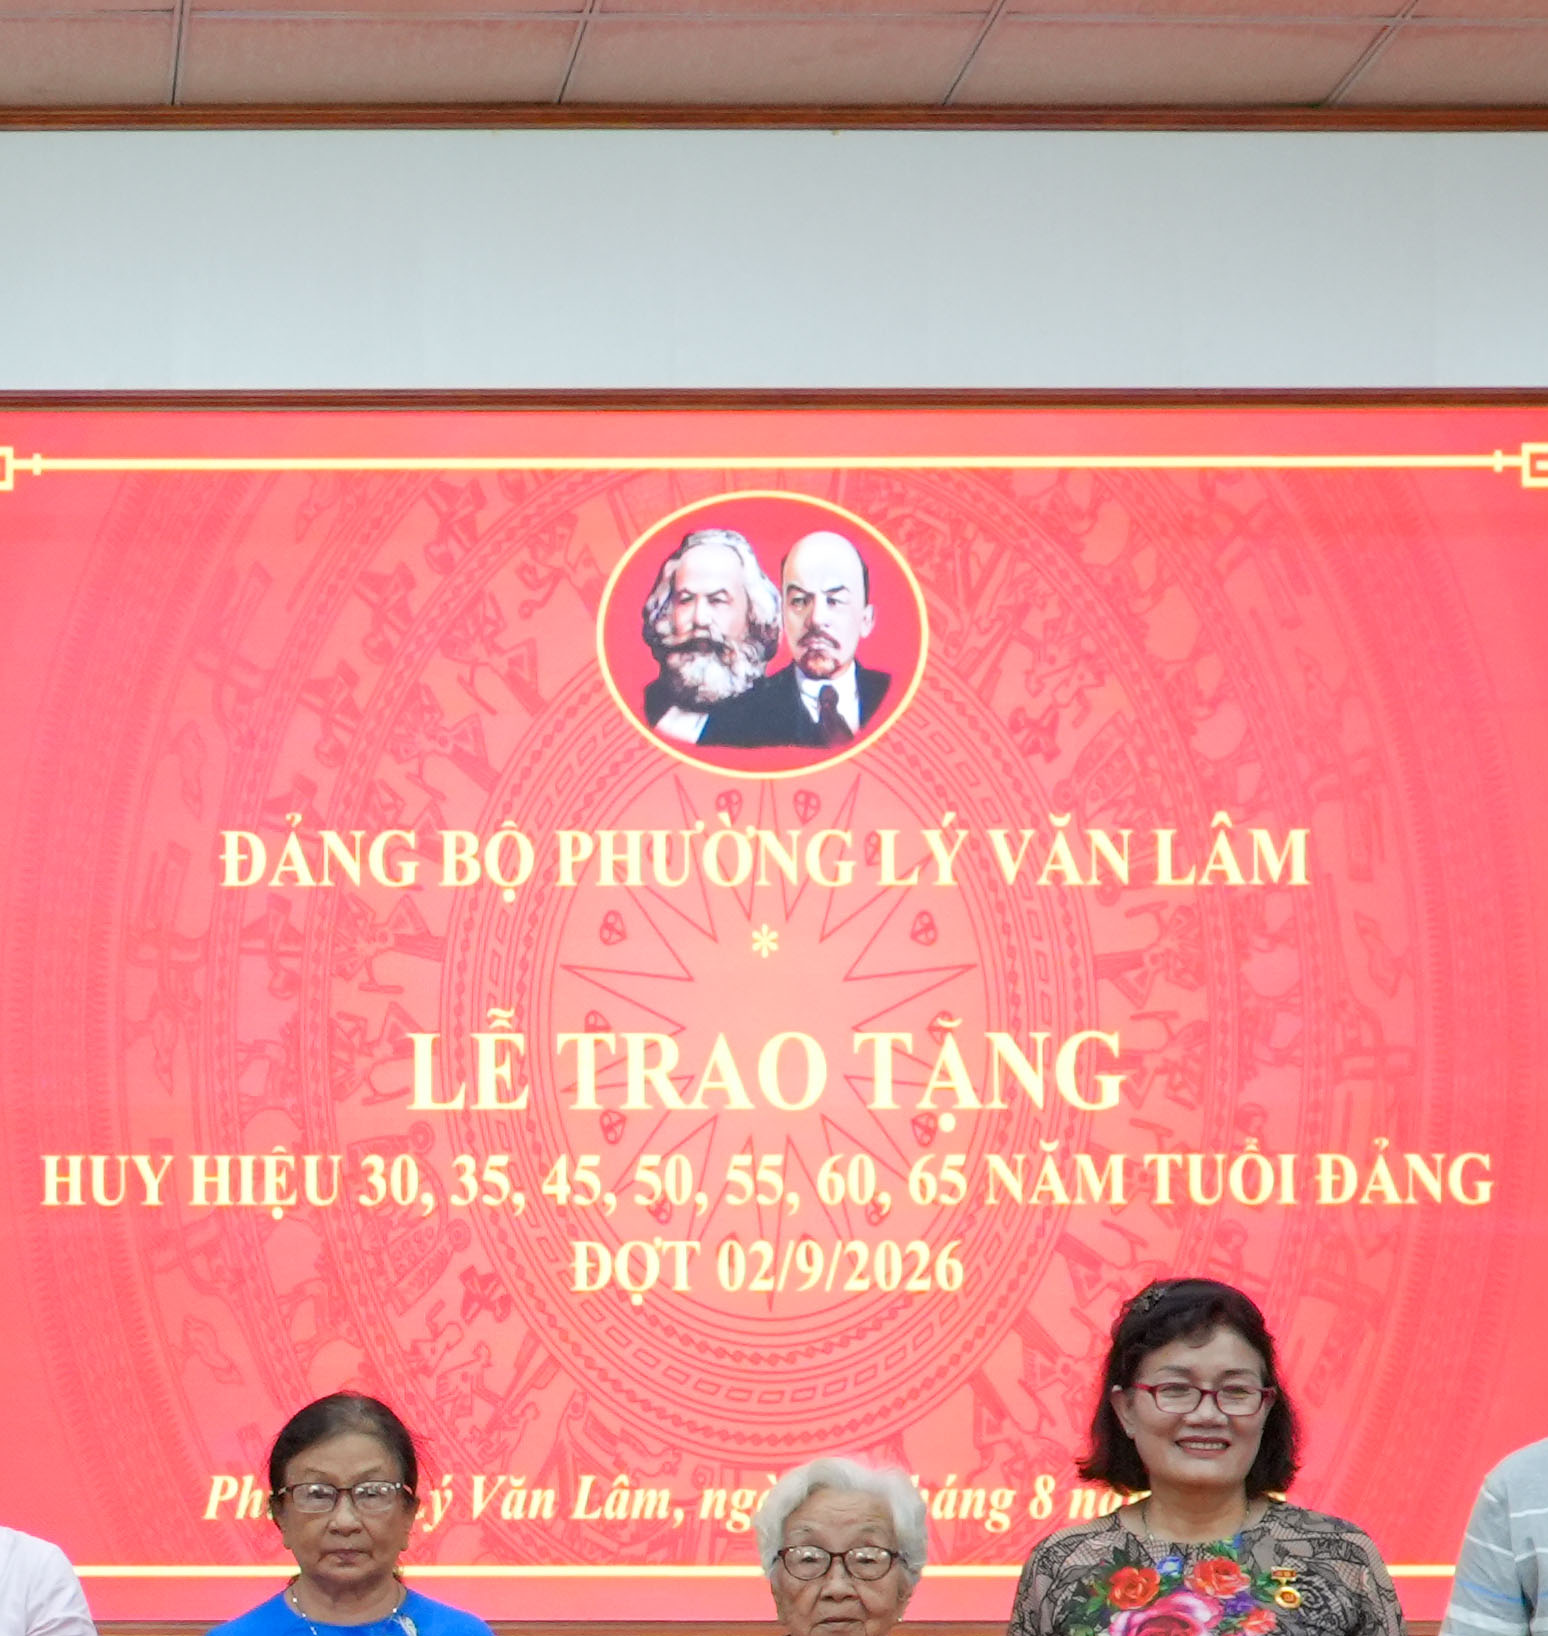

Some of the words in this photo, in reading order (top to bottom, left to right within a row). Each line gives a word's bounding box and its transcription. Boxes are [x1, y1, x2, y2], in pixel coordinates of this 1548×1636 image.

[219, 811, 421, 888] ĐẢNG
[438, 818, 535, 902] BỘ
[555, 811, 858, 889] PHƯỜNG
[875, 810, 969, 887] LÝ
[986, 811, 1133, 887] VĂN
[1153, 809, 1311, 887] LÂM
[406, 1007, 531, 1111] LỄ
[555, 1030, 830, 1113] TRAO
[852, 1017, 1128, 1134] TẶNG
[42, 1154, 174, 1206] HUY
[189, 1144, 343, 1218] HIỆU
[358, 1153, 435, 1217] 30,
[449, 1153, 526, 1217] 35,
[541, 1153, 618, 1217] 45,
[633, 1152, 710, 1217] 50,
[724, 1153, 801, 1217] 55,
[816, 1152, 893, 1216] 60,
[907, 1152, 968, 1207] 65
[983, 1138, 1127, 1205] NĂM
[1143, 1136, 1297, 1206] TUỔI
[1315, 1136, 1493, 1206] ĐẢNG
[569, 1235, 703, 1306] ĐỢT
[716, 1239, 965, 1294] 02/9/2026
[473, 1474, 556, 1520] Văn
[571, 1472, 685, 1528] Lâm,
[1028, 1474, 1056, 1520] 8
